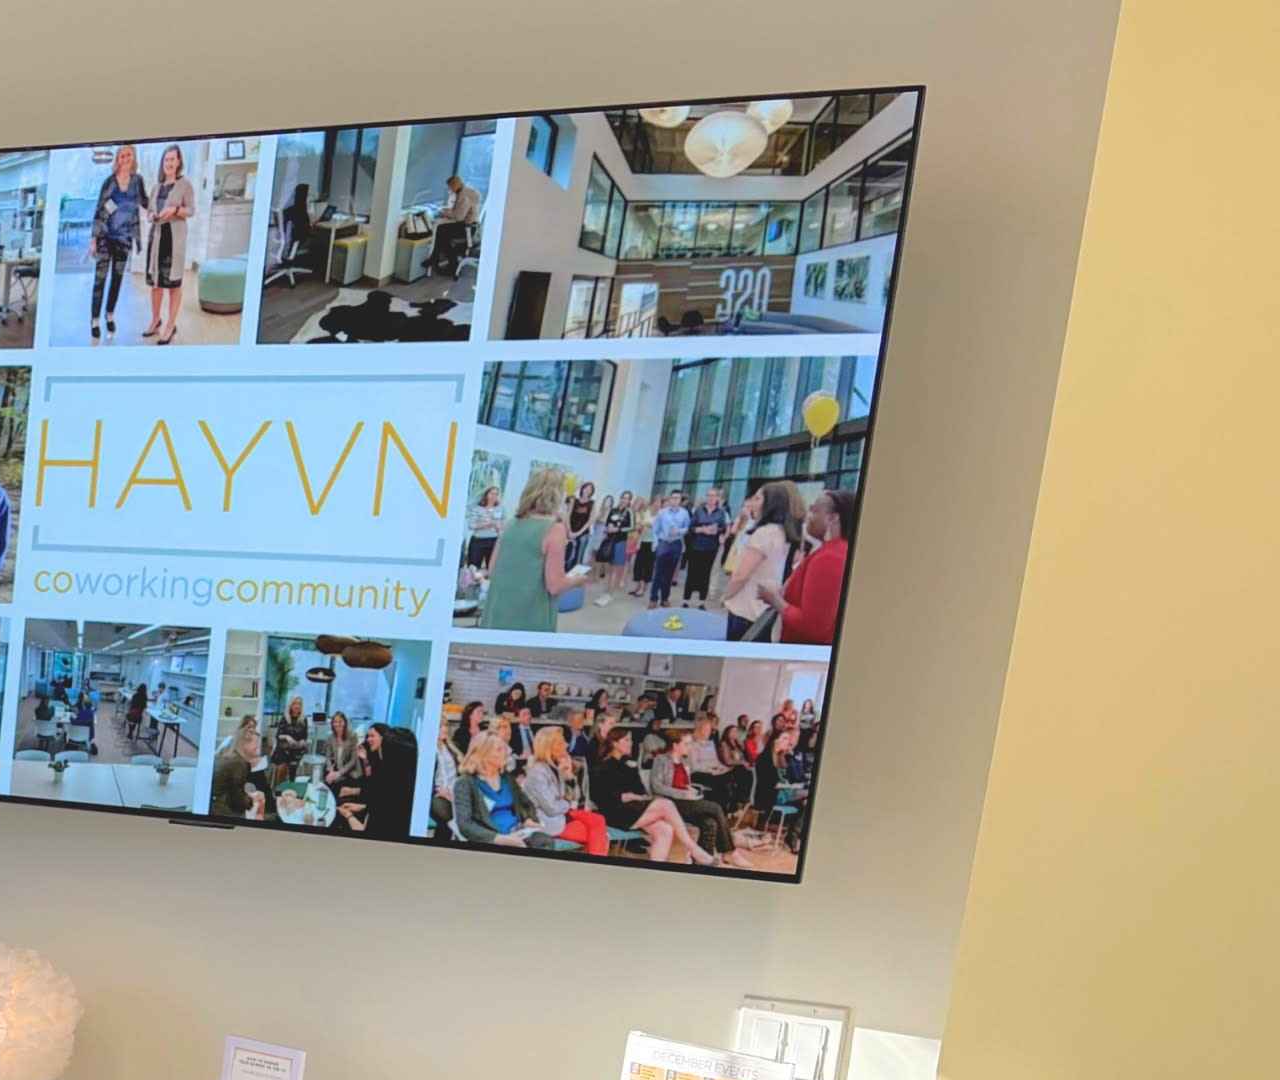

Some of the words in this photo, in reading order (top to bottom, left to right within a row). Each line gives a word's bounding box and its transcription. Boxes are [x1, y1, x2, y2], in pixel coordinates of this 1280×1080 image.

[35, 418, 458, 519] HAYVN
[34, 567, 431, 618] coworkingcommunity
[714, 1062, 760, 1080] EVENTS
